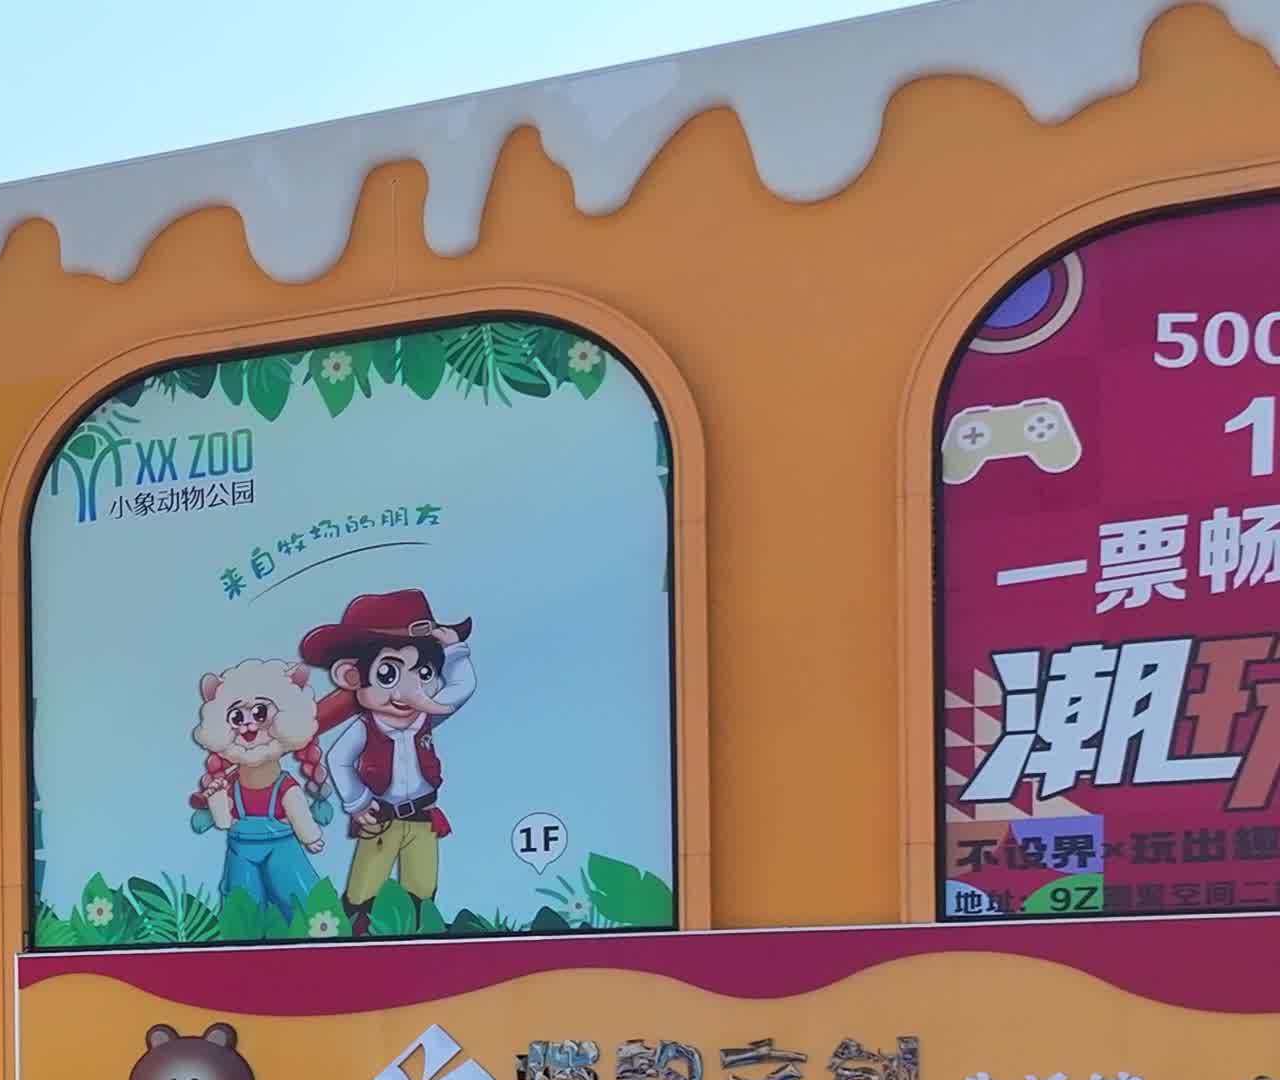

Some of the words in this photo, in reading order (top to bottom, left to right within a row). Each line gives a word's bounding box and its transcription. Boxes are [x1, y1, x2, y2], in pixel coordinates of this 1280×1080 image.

[135, 435, 178, 485] XX
[189, 428, 253, 481] ZOO
[109, 479, 254, 519] 小象动物公园
[219, 503, 442, 600] 来自牧场的朋友
[519, 825, 560, 854] 1F
